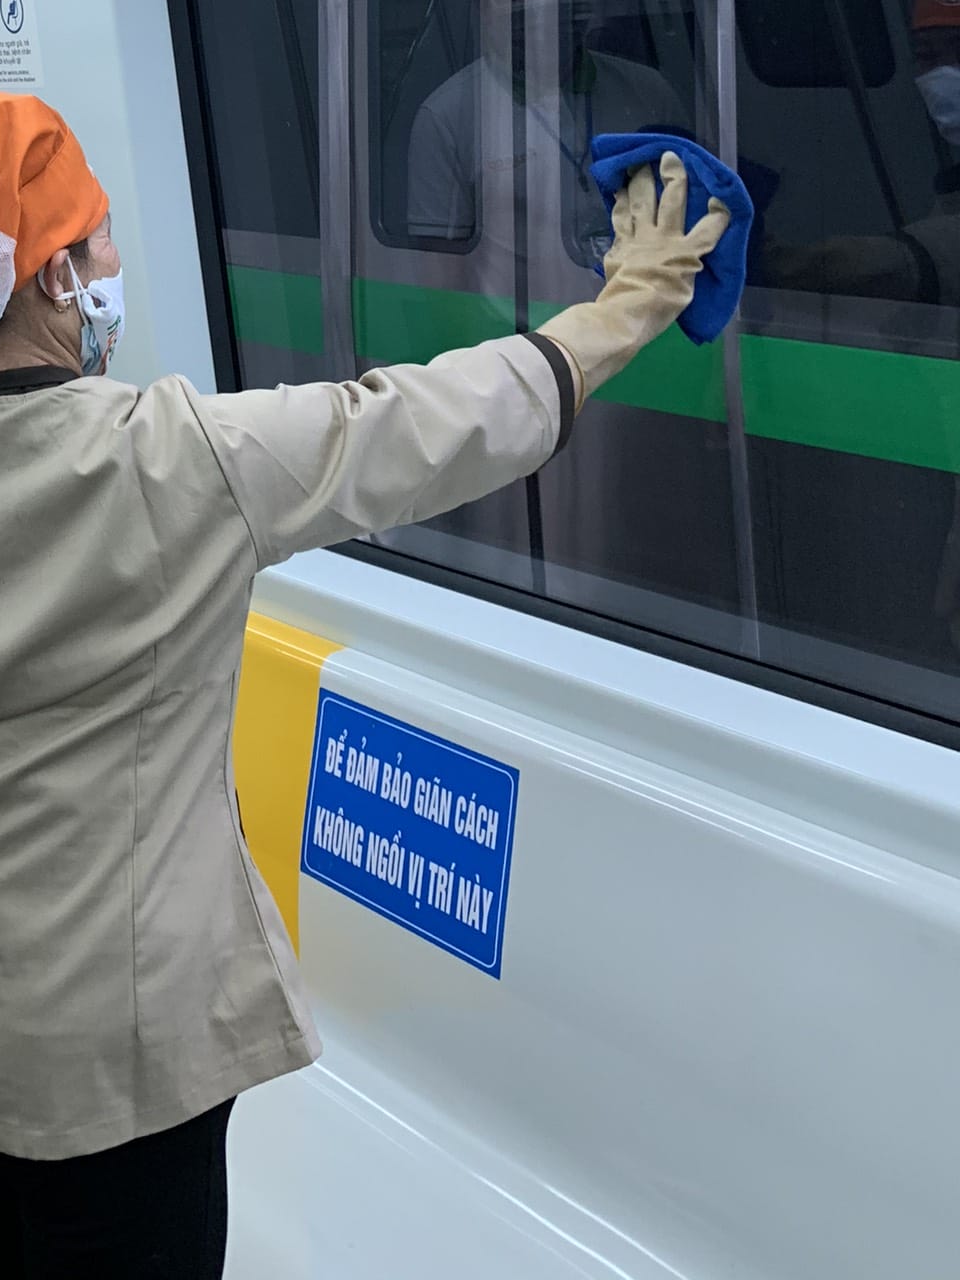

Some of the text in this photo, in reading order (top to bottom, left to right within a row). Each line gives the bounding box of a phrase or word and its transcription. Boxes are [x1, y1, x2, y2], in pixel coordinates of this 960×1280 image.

[324, 728, 499, 850] ĐỂ ĐẢM BẢO GIÃN CÁCH
[312, 805, 494, 935] KHÔNG NGỒI VỊ TRÍ NÀY
